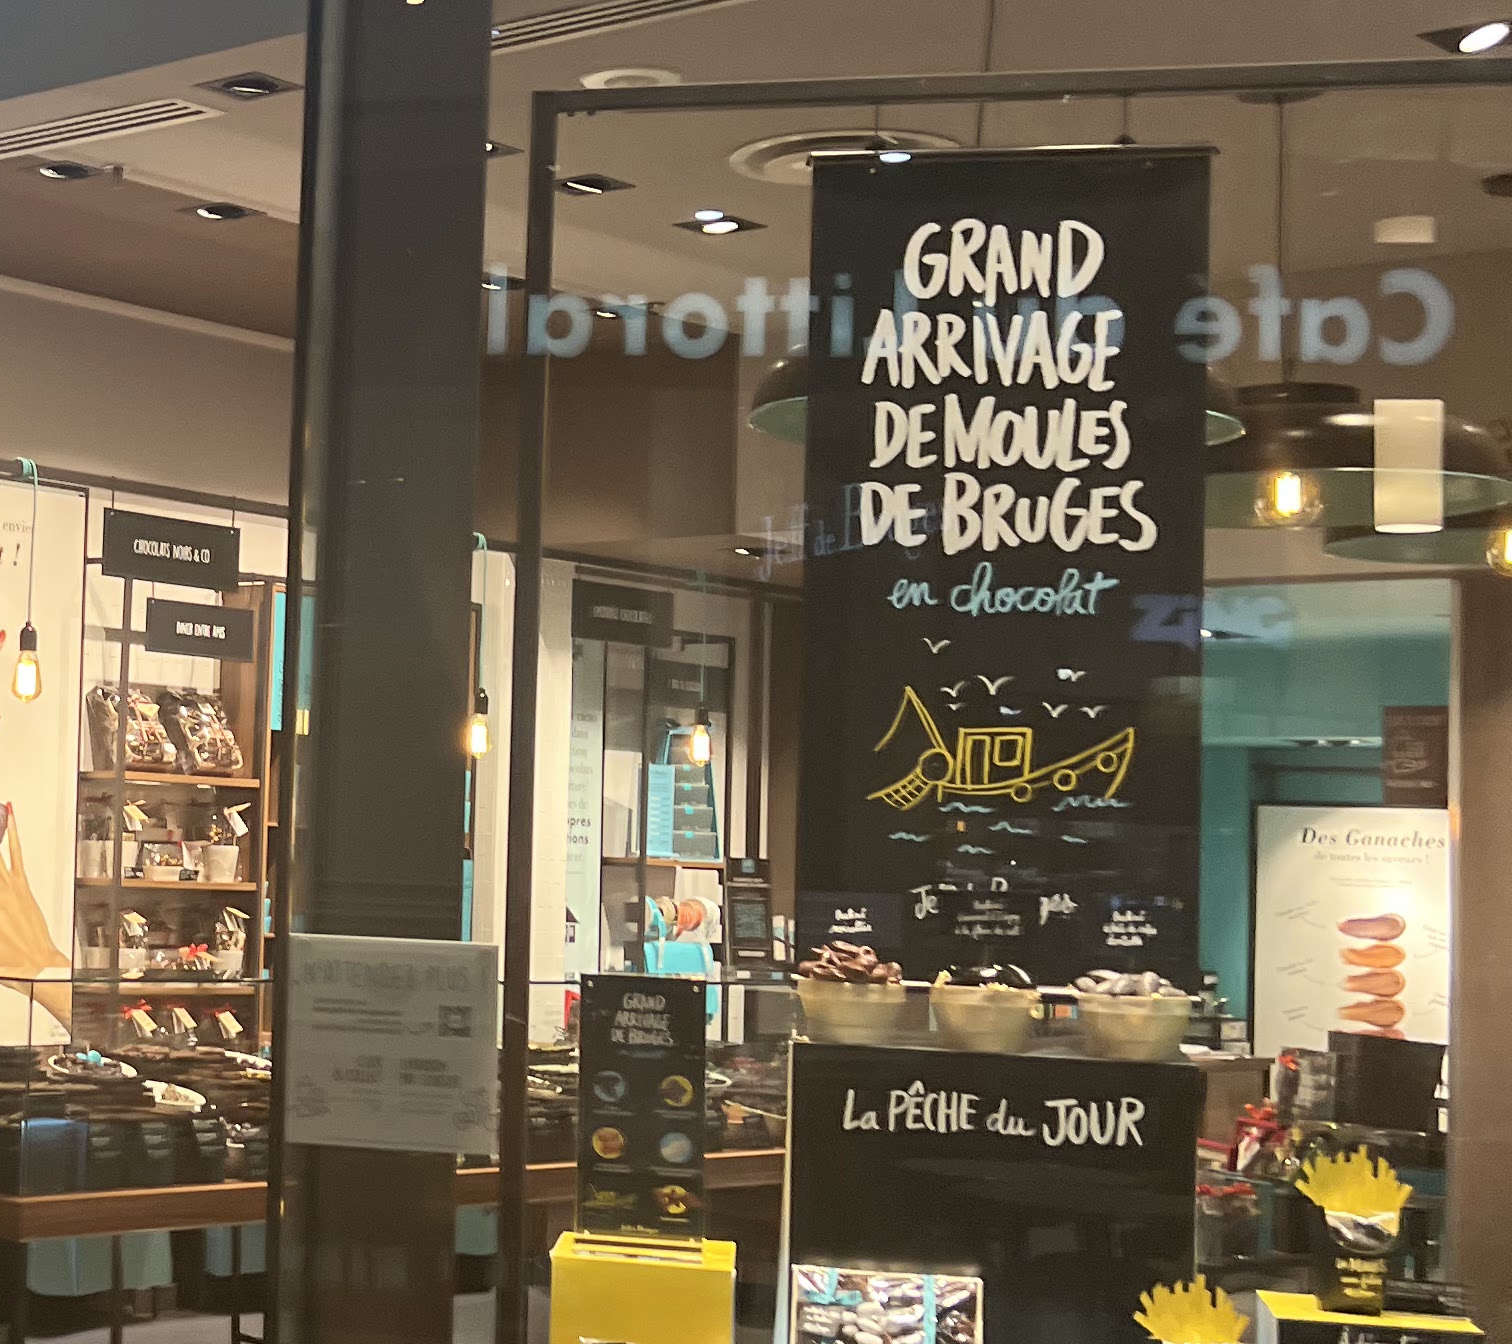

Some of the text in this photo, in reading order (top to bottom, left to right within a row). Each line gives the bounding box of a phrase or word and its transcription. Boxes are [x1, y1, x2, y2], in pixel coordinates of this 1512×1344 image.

[902, 217, 1106, 307] GRAND
[860, 301, 1123, 392] ARRIVAGE
[868, 392, 1131, 473] DE MOULES
[860, 480, 928, 548] DE
[942, 472, 1158, 556] BRUGES
[886, 561, 1121, 617] en chocolat
[1301, 826, 1447, 849] Des Ganaches
[842, 1079, 1146, 1147] La PÊCHE du JOUR
